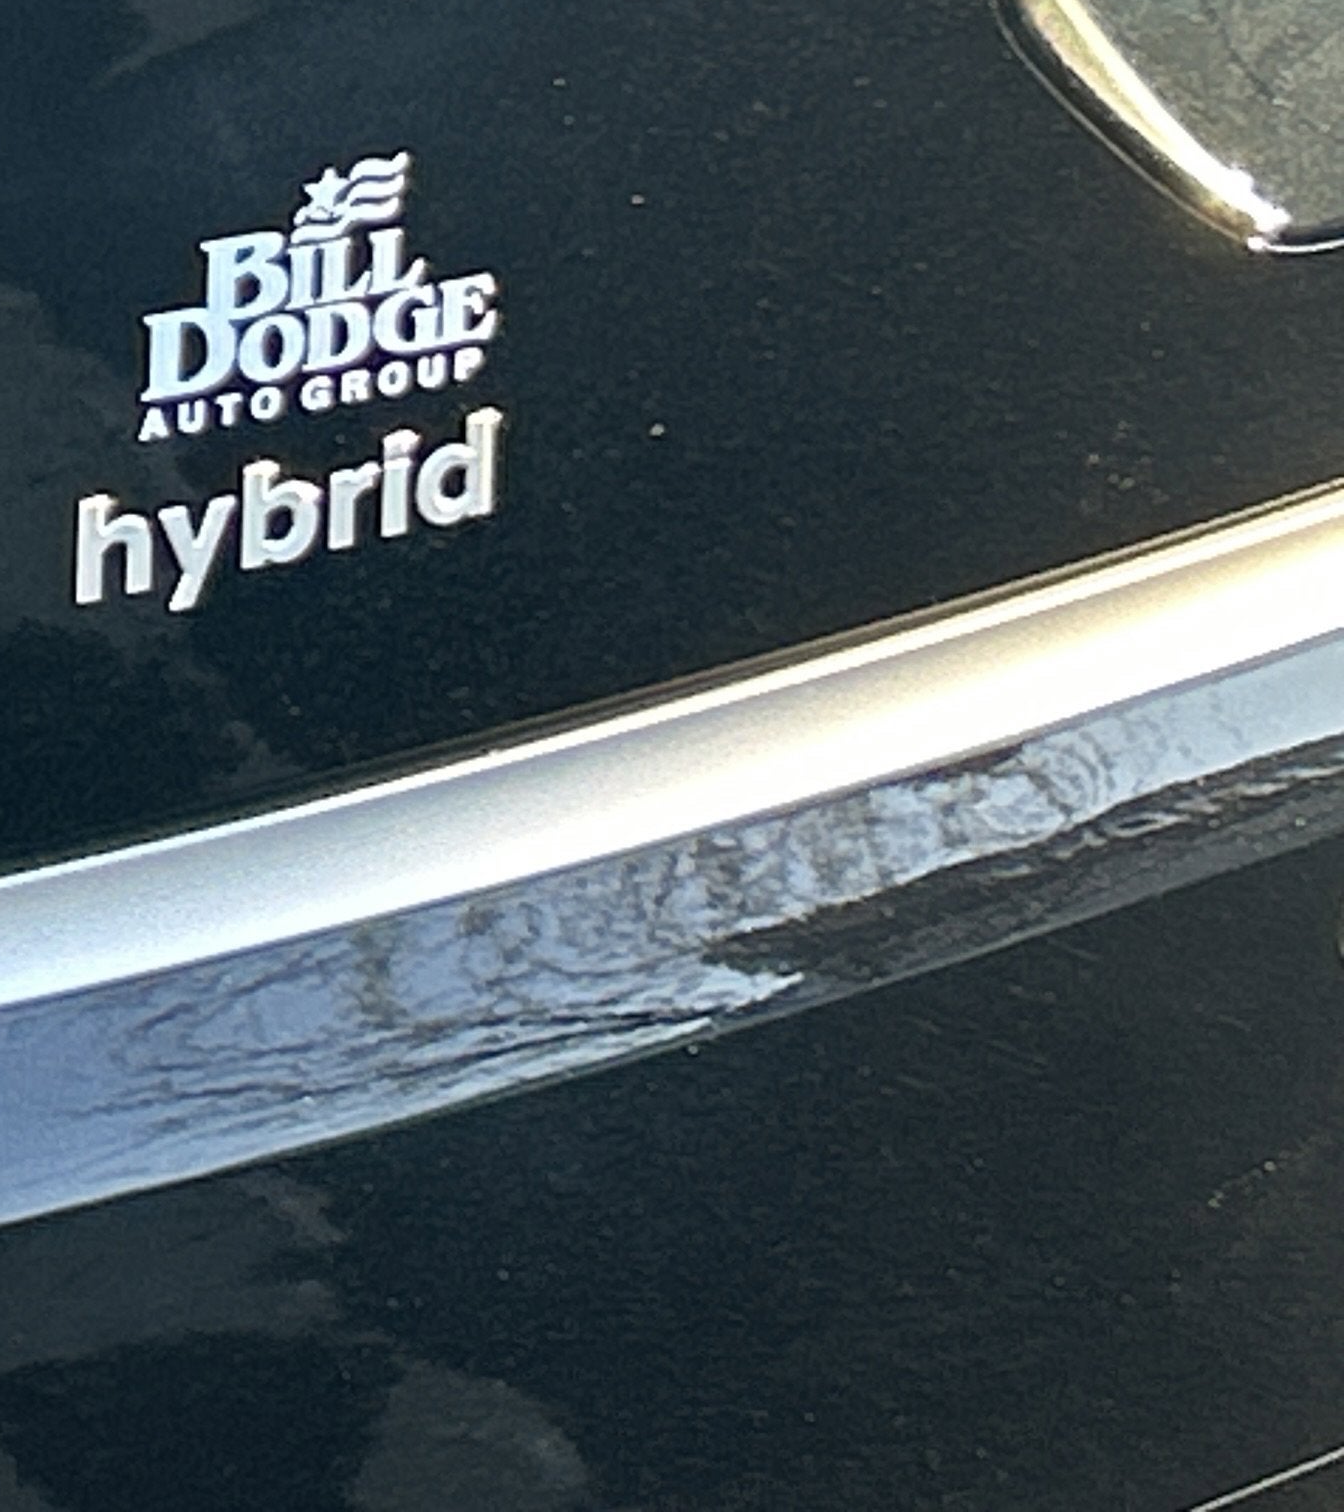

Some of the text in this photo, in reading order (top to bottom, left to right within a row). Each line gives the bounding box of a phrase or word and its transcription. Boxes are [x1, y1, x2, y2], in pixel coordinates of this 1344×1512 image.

[200, 228, 427, 322] BILL
[139, 273, 497, 402] DODGE
[137, 347, 486, 443] AUTO GROUP
[74, 406, 503, 612] hybrid
